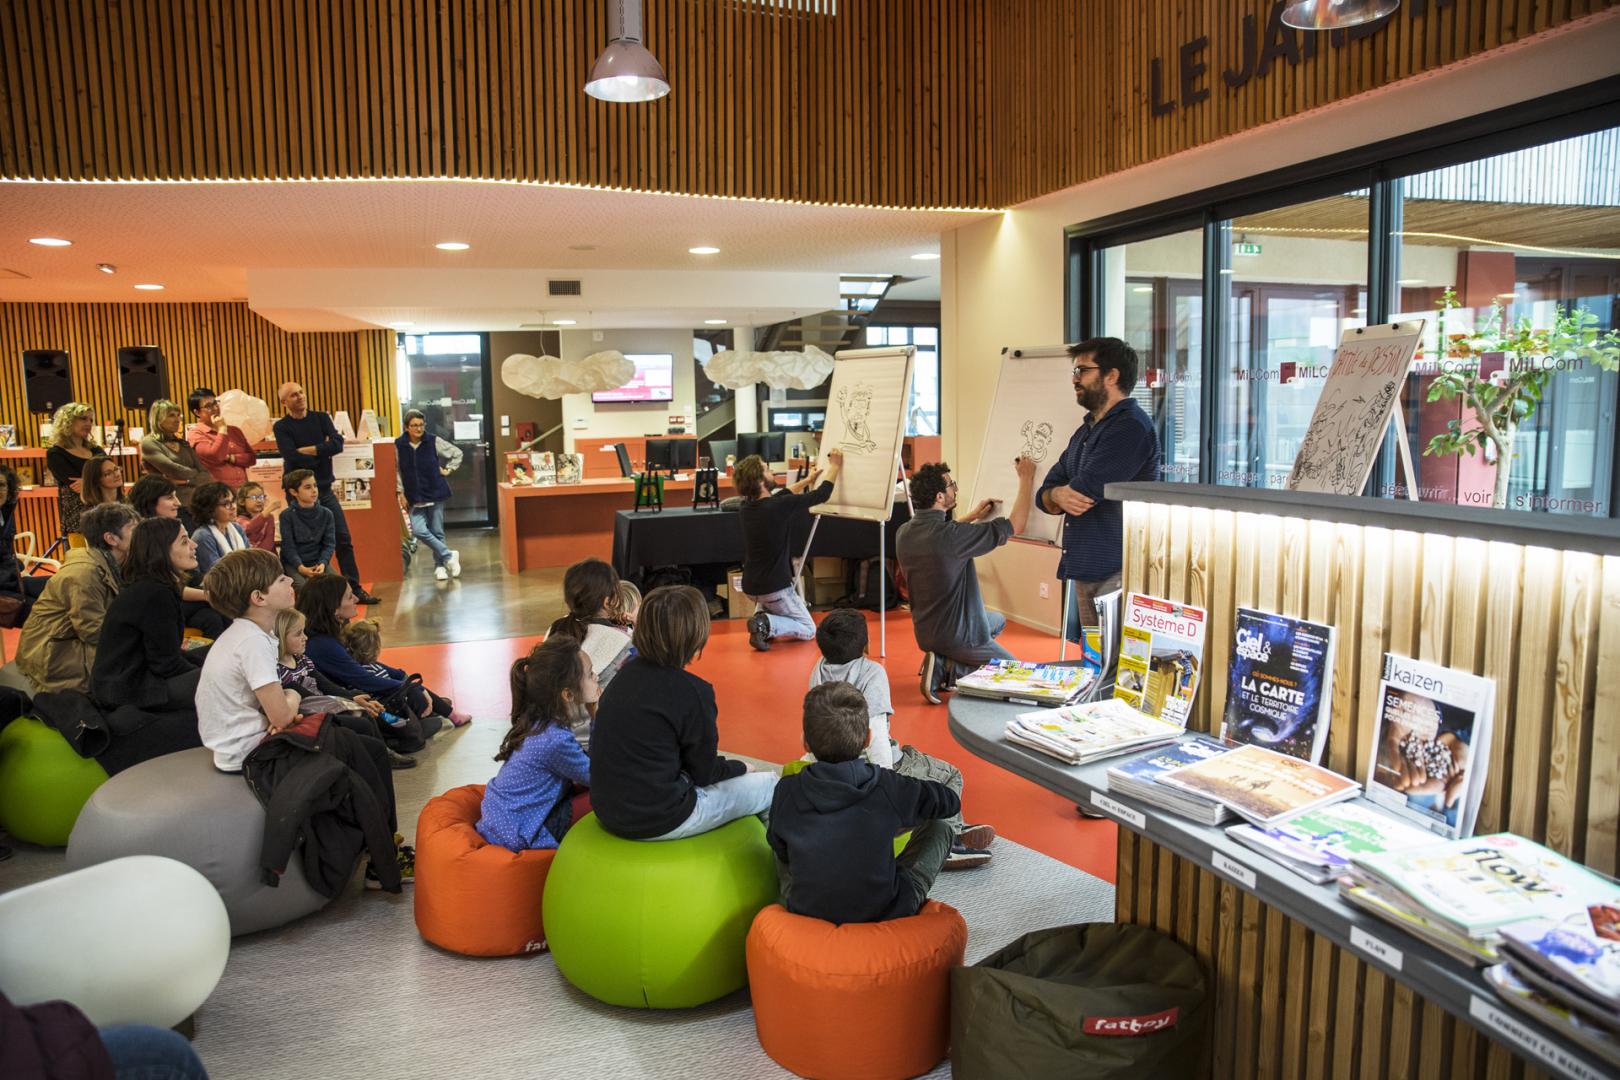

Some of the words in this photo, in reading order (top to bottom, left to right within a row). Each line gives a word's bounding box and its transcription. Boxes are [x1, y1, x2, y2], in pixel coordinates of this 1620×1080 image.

[1151, 36, 1209, 116] LE
[1237, 368, 1280, 381] MiLCom
[1509, 355, 1584, 372] MiLCom
[1464, 488, 1492, 504] voir
[1516, 492, 1602, 513] s'informer
[1132, 608, 1185, 634] Système
[1187, 622, 1197, 637] D
[1236, 628, 1263, 651] Ciel
[1263, 641, 1271, 655] &
[1236, 645, 1269, 663] espace
[1394, 664, 1443, 694] kaizen
[1242, 676, 1256, 692] LA
[1260, 682, 1305, 705] CARTE
[1242, 691, 1250, 700] ET
[1251, 693, 1260, 703] LE
[1261, 696, 1299, 715] TERRITOIRE
[1250, 703, 1287, 720] COSMIQUE
[1095, 1016, 1170, 1033] fatboy
[1488, 1012, 1538, 1048] COMMENT
